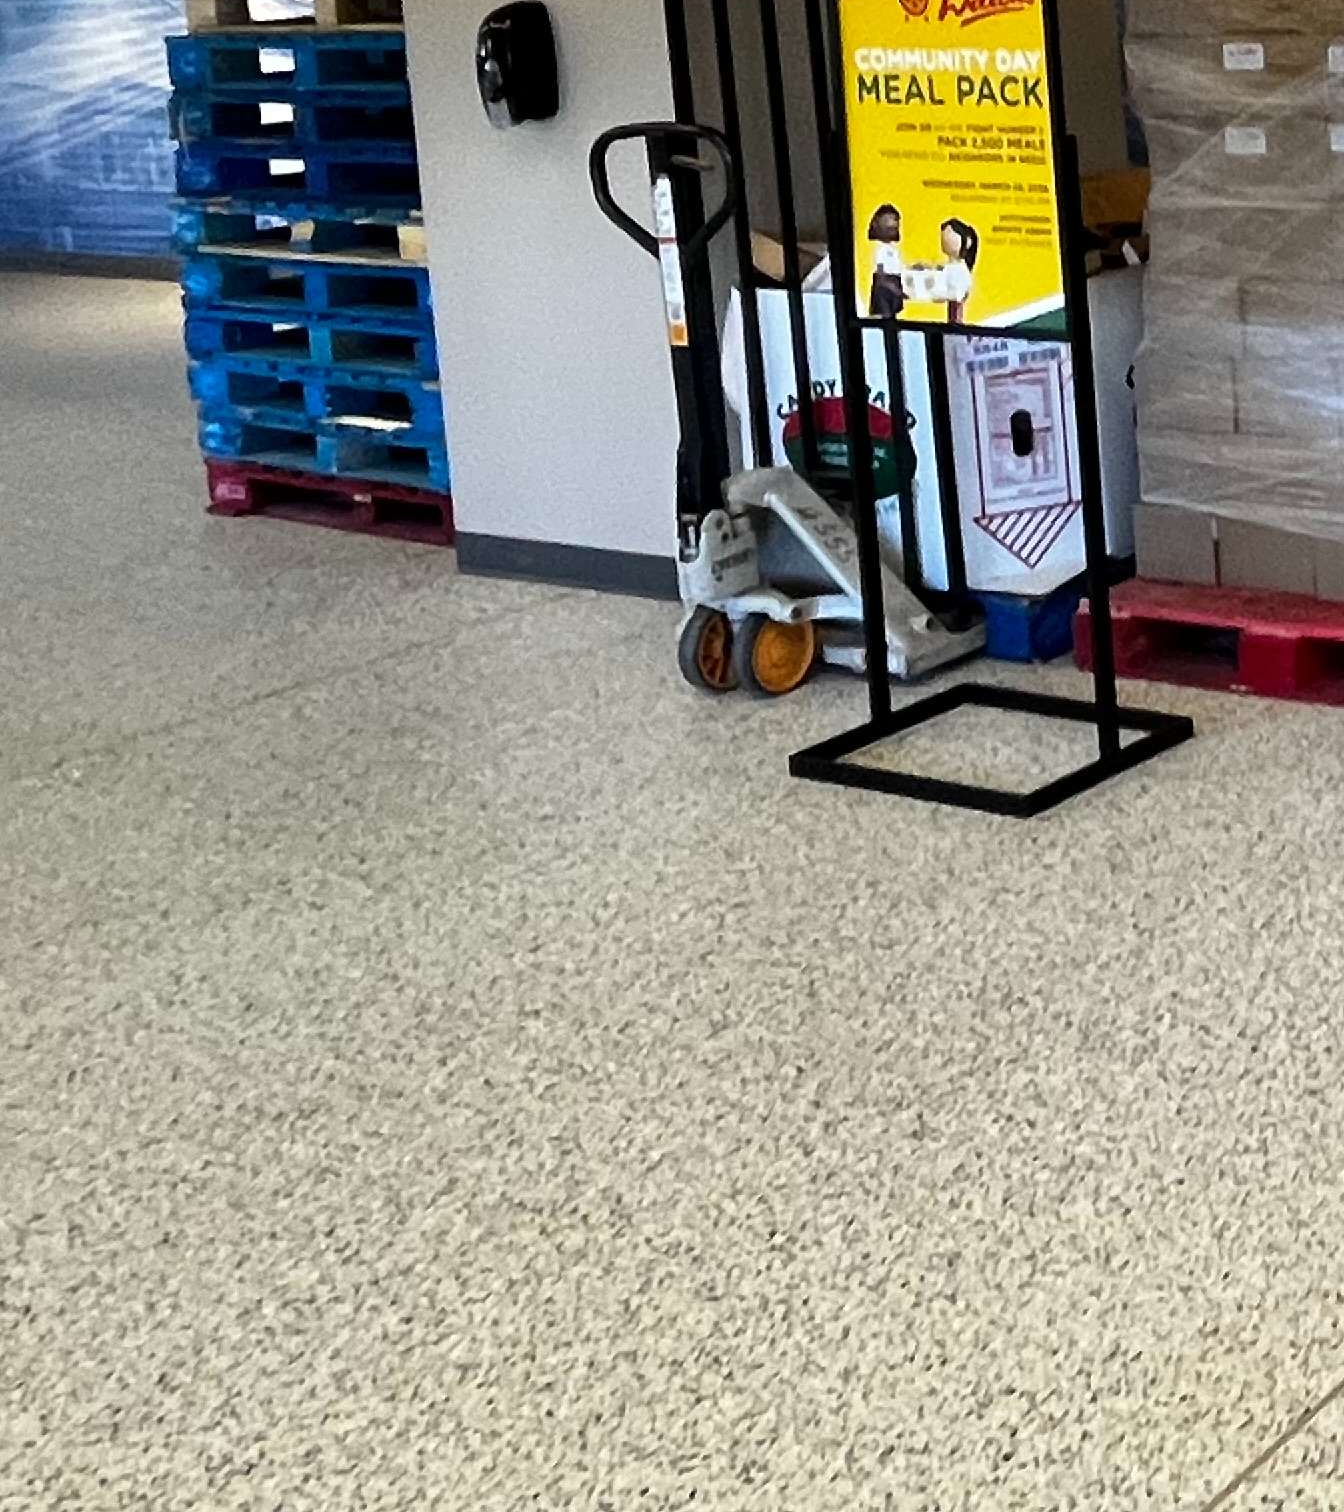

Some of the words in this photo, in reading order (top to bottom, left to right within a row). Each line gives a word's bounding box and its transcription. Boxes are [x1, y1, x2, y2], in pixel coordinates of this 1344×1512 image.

[854, 47, 989, 72] COMMUNITY
[996, 47, 1041, 73] DAY
[857, 74, 945, 105] MEAL
[957, 75, 1043, 108] PACK
